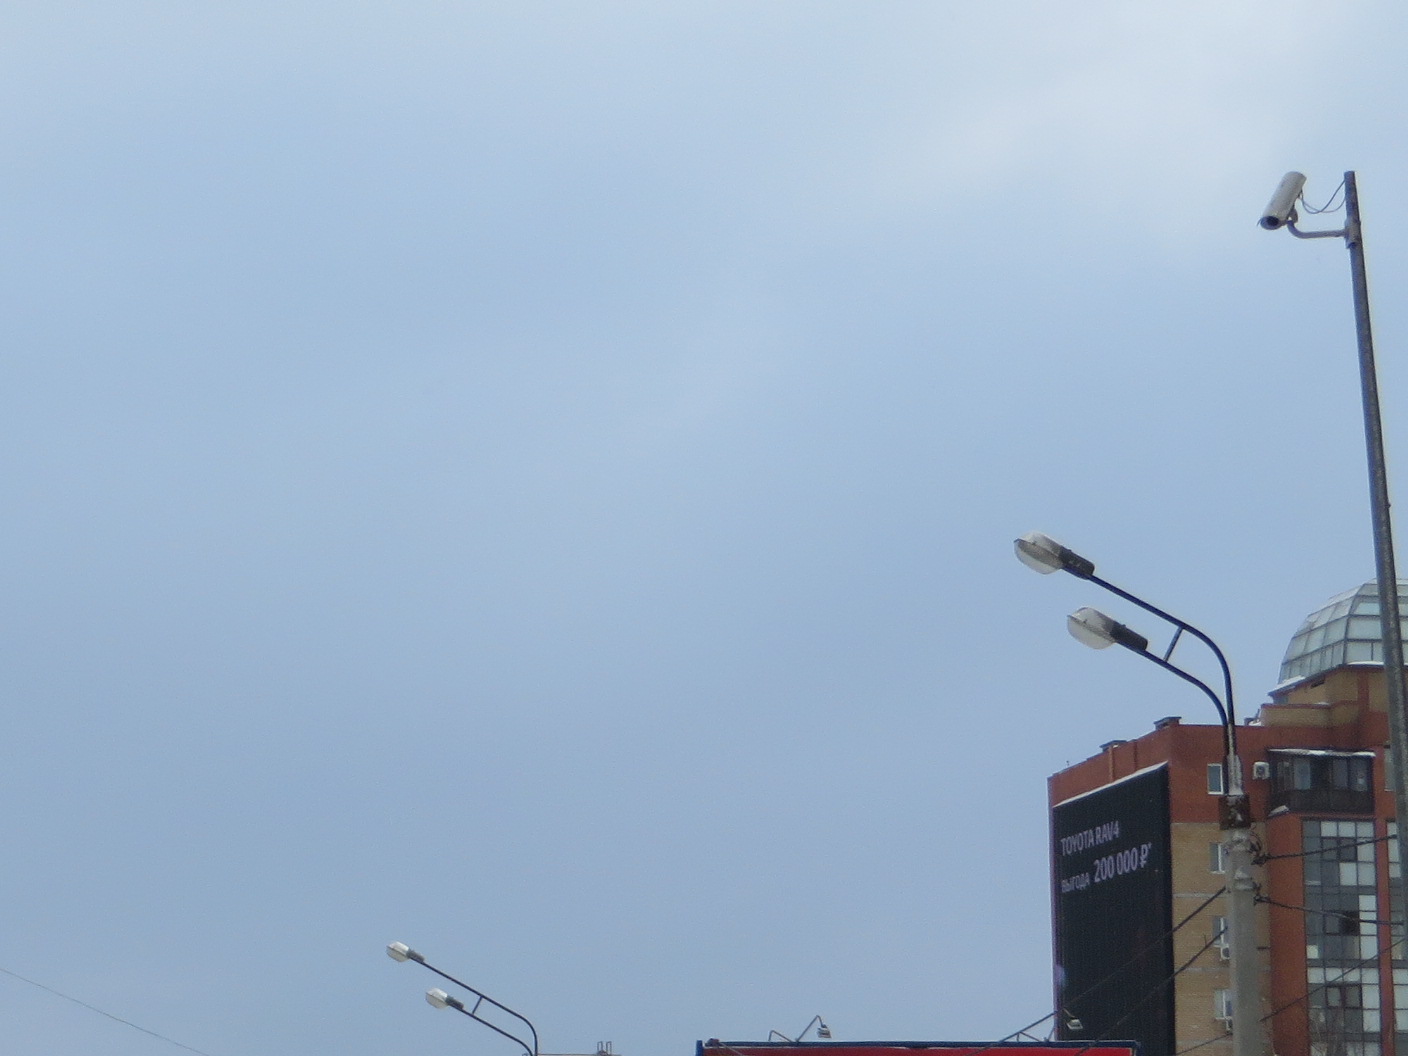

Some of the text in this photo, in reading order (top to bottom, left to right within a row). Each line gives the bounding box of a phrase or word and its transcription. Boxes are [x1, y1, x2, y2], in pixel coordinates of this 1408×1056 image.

[1061, 820, 1120, 856] TOYOTA RAV4
[1093, 856, 1115, 882] 200
[1116, 846, 1138, 876] 000
